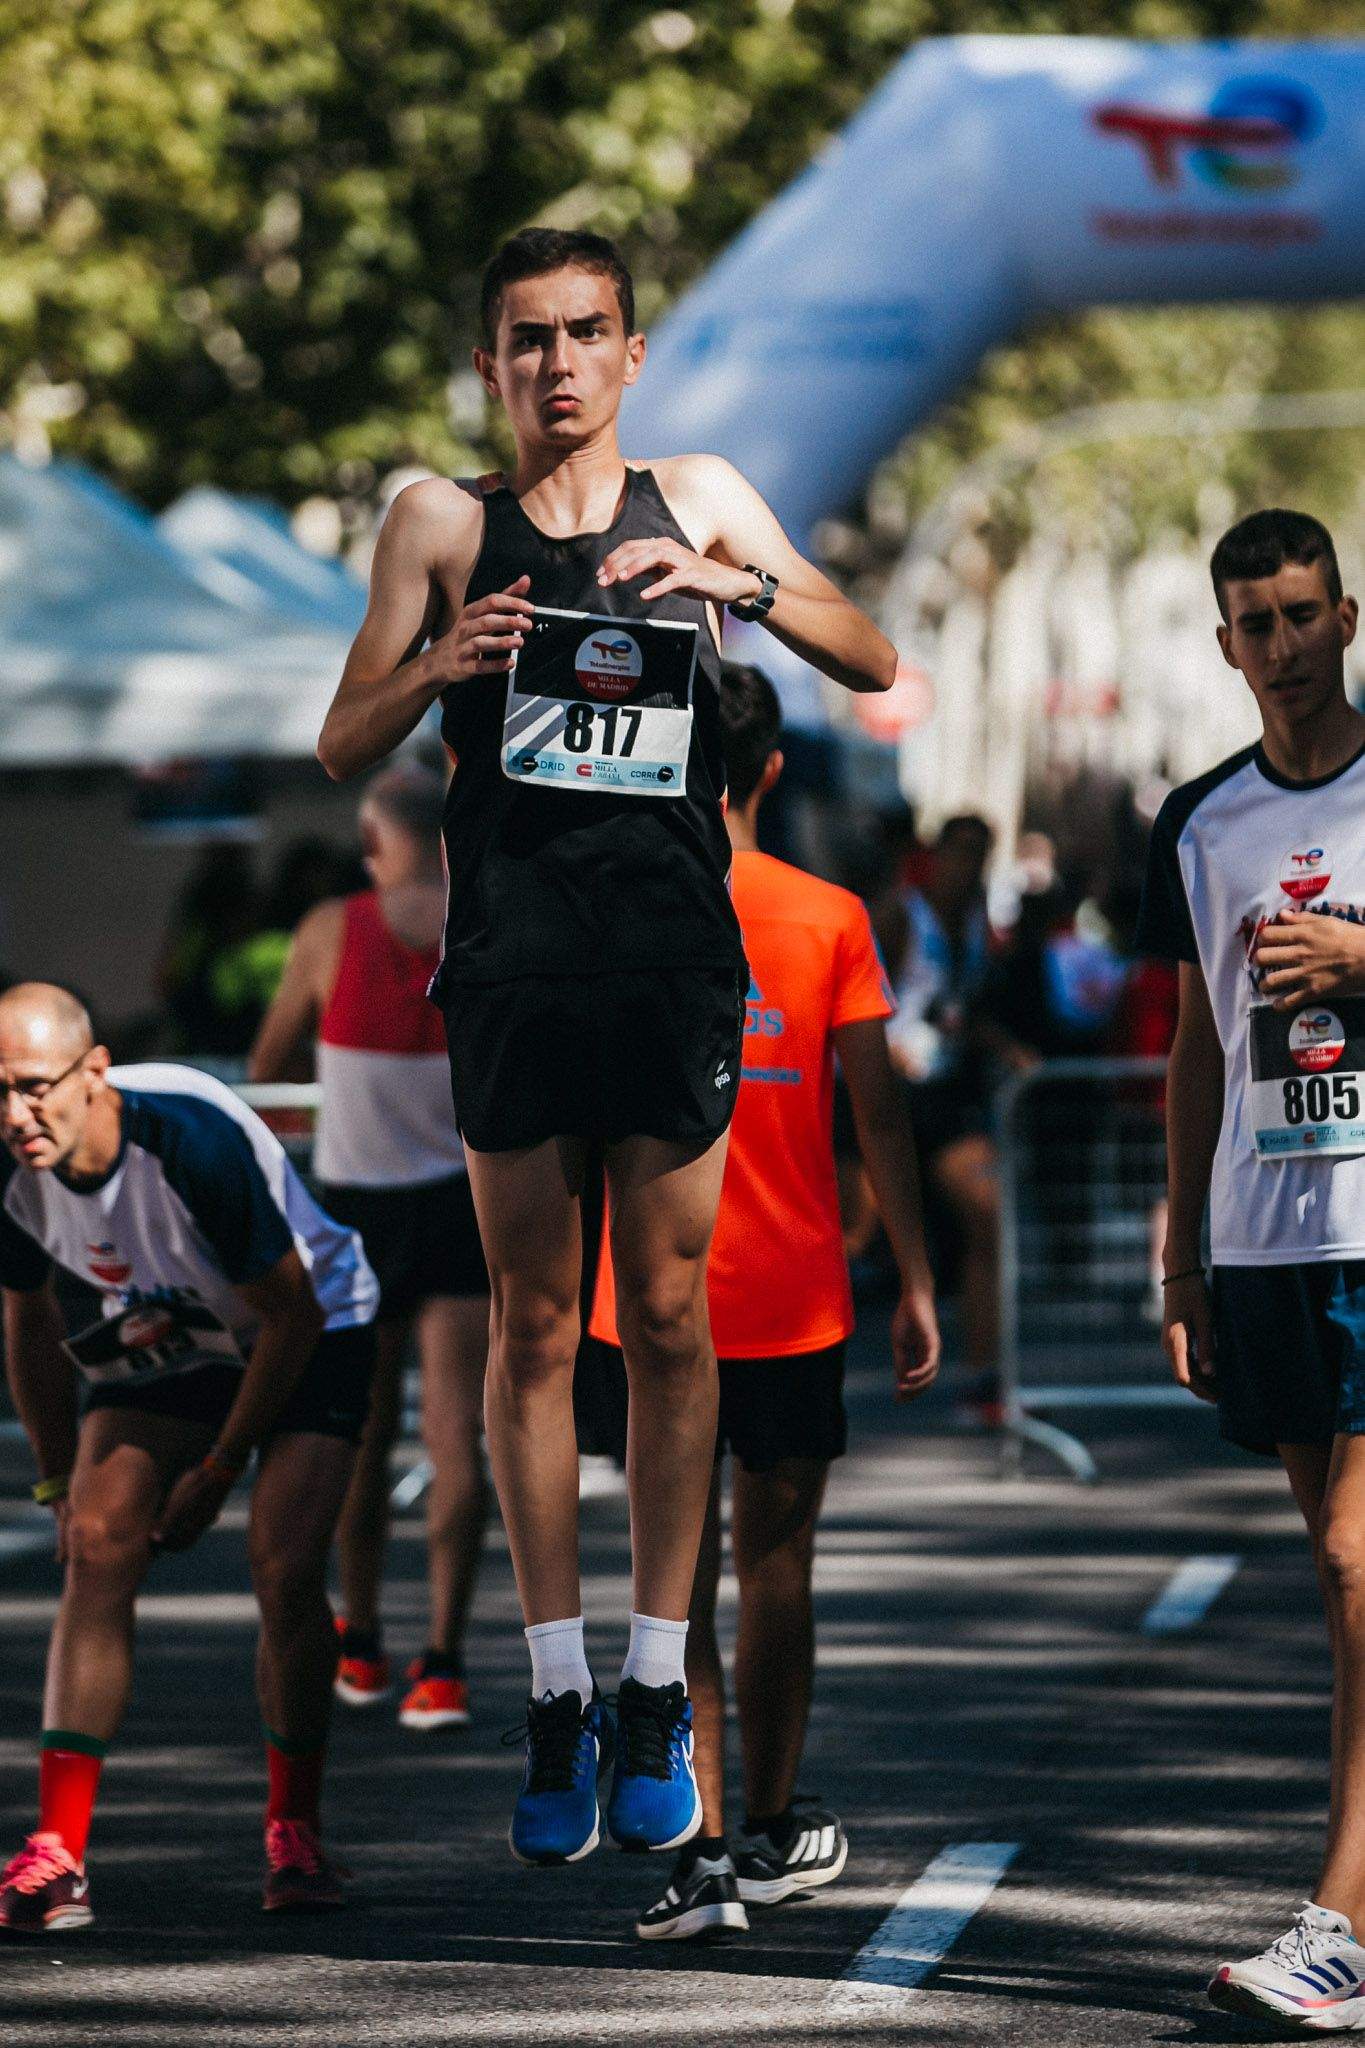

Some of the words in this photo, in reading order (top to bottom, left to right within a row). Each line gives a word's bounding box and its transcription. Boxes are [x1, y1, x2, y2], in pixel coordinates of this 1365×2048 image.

[597, 674, 620, 682] MILLA
[600, 682, 629, 692] MADRID
[563, 702, 642, 757] 817
[594, 765, 617, 773] MILLA
[1283, 1074, 1361, 1125] 805
